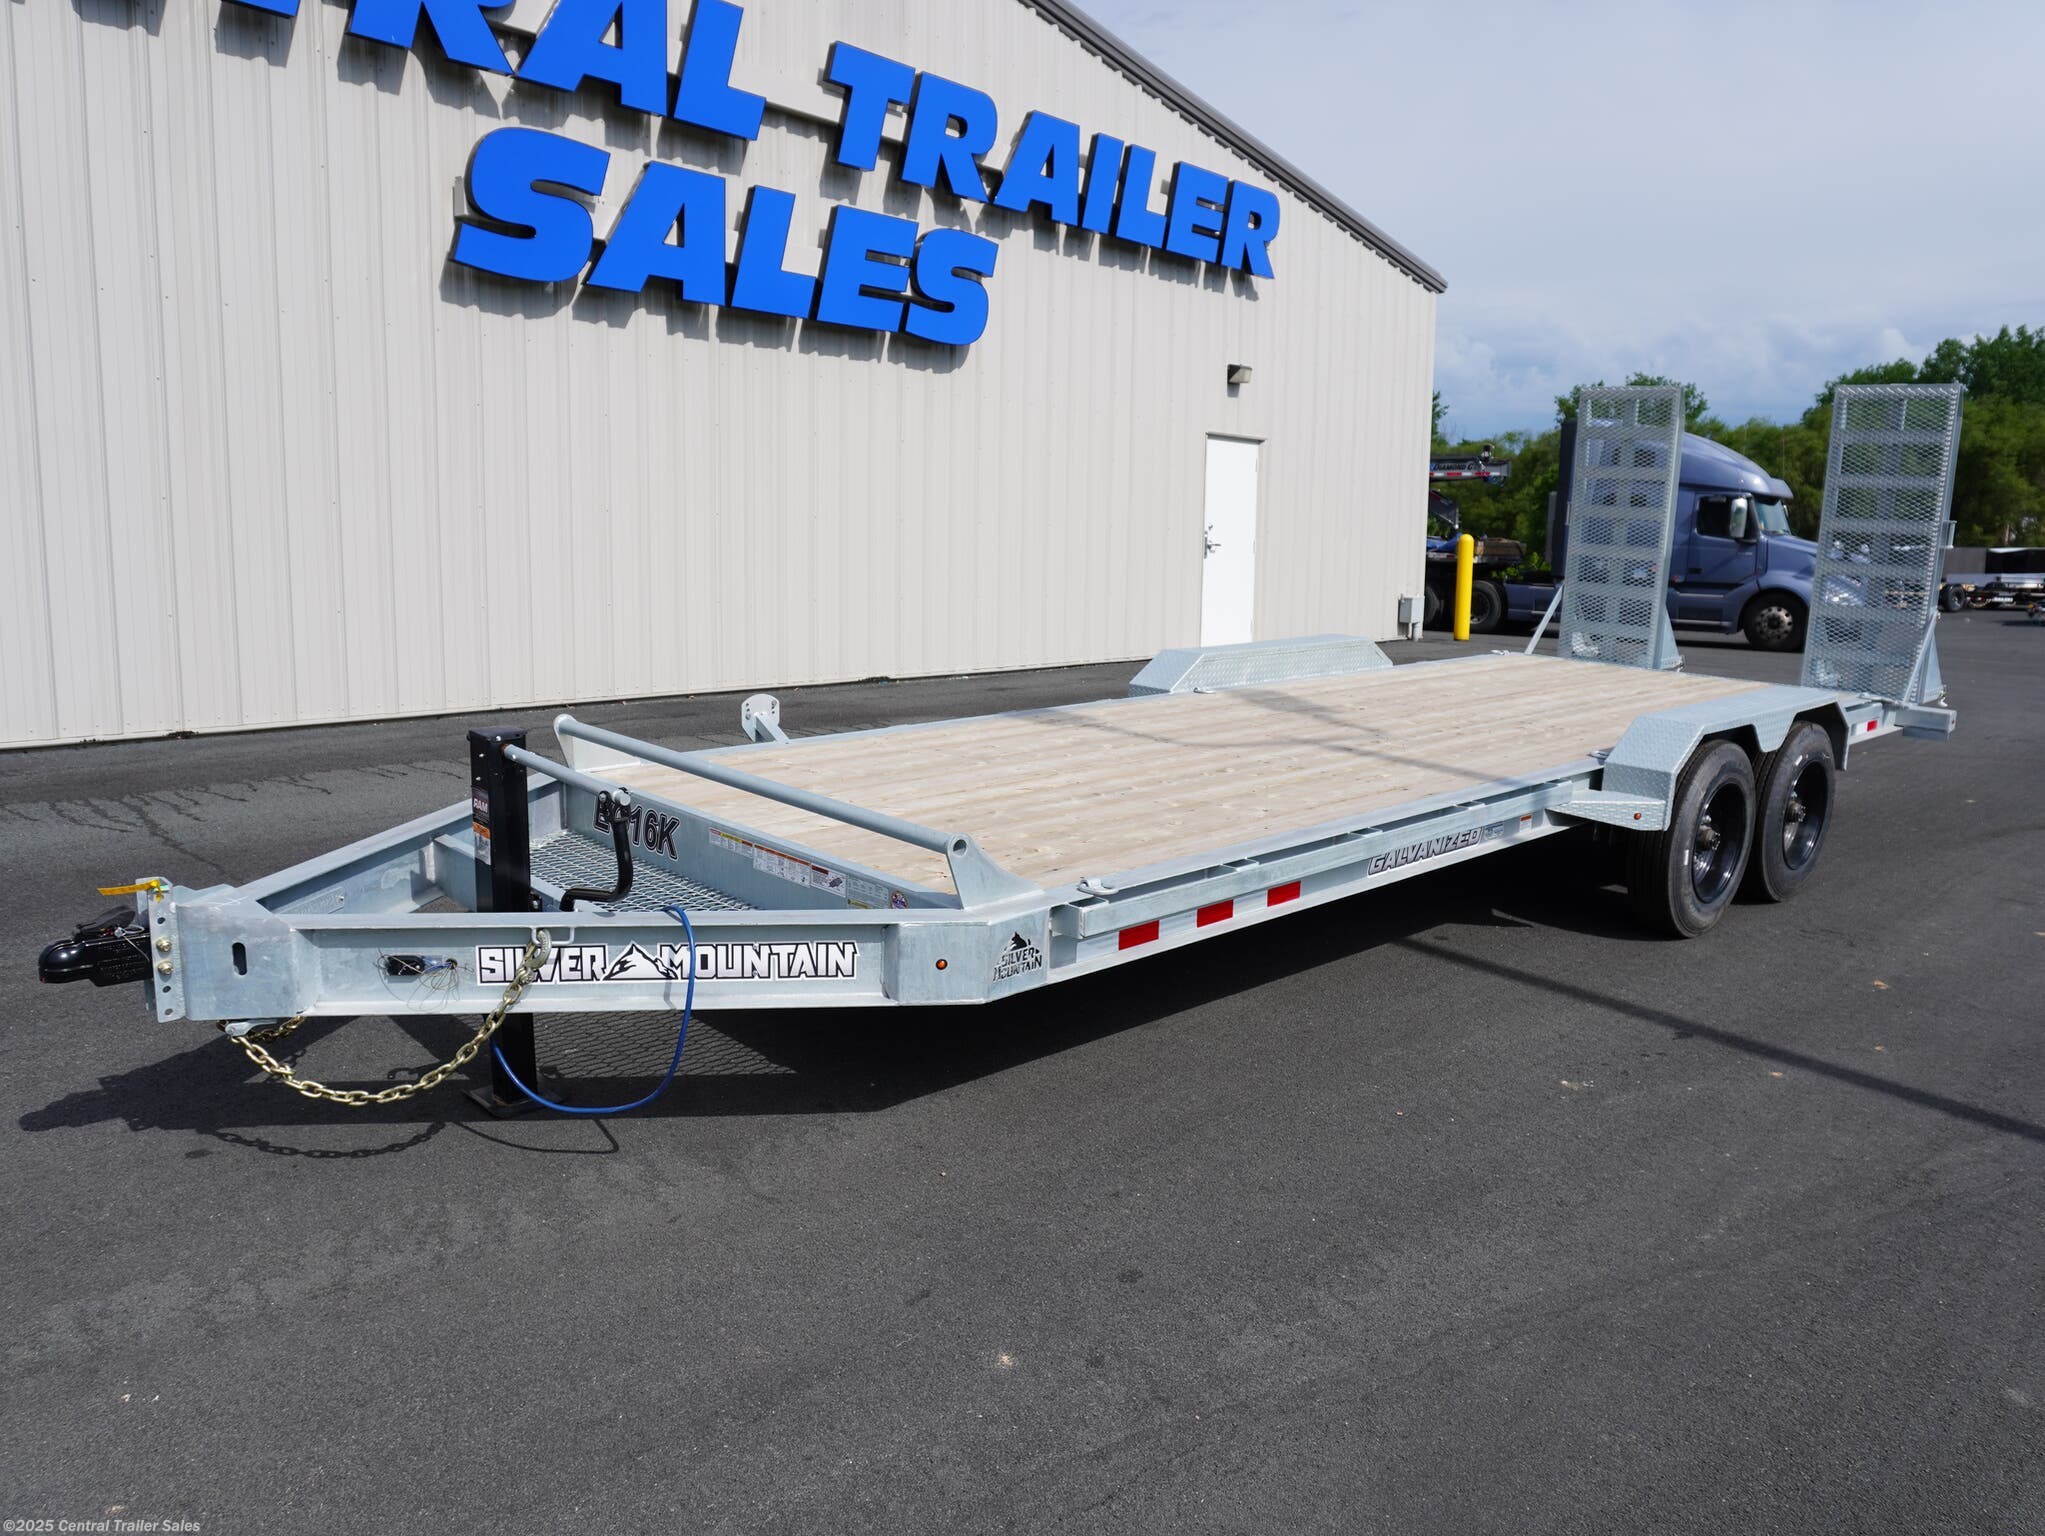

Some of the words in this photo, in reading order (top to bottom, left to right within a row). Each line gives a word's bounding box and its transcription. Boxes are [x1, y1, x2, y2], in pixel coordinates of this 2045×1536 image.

[823, 40, 1280, 279] TRAILER
[450, 126, 998, 345] SALES
[473, 798, 489, 814] RAM
[1368, 826, 1483, 876] GALVANIZED
[659, 941, 859, 980] MOUNTAIN
[992, 954, 1043, 982] MOUNTAIN
[1001, 946, 1035, 967] SILVER
